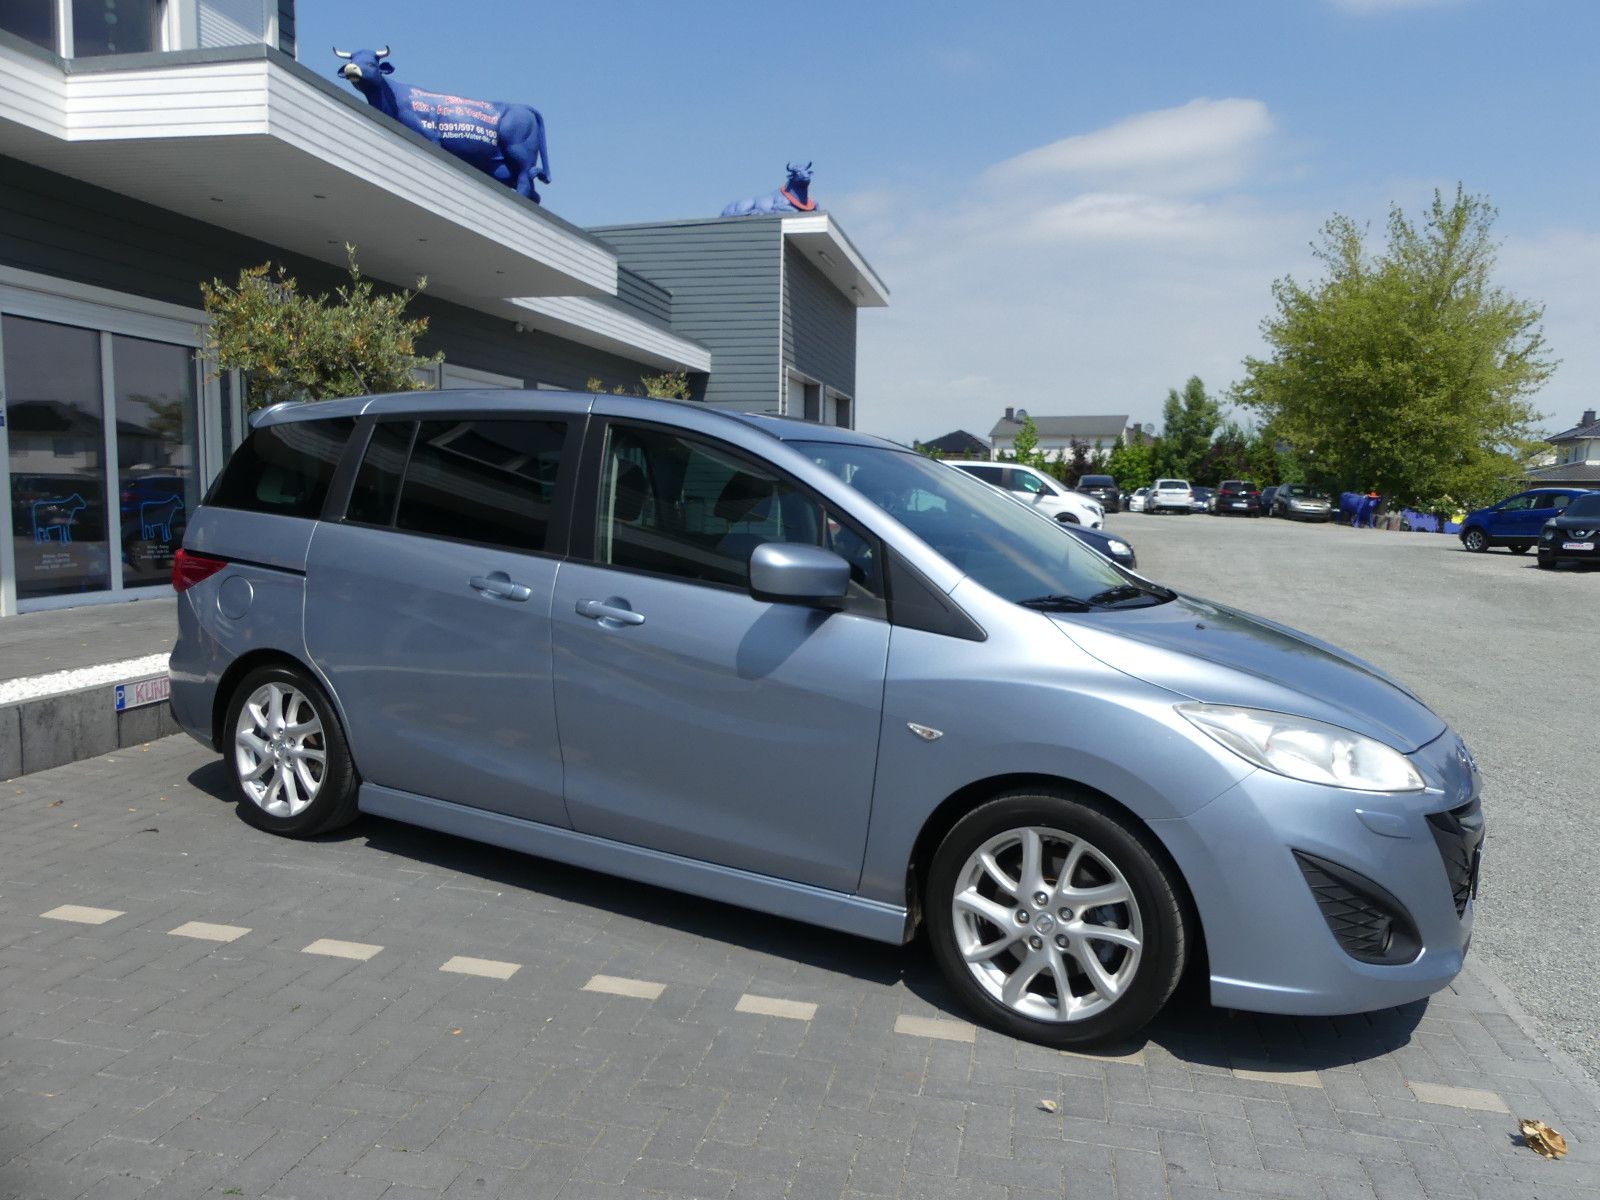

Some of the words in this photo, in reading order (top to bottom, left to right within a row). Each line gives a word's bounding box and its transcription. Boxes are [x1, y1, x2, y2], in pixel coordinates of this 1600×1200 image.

[421, 120, 437, 130] Tel.
[438, 122, 475, 132] 0391/597
[116, 690, 124, 705] P
